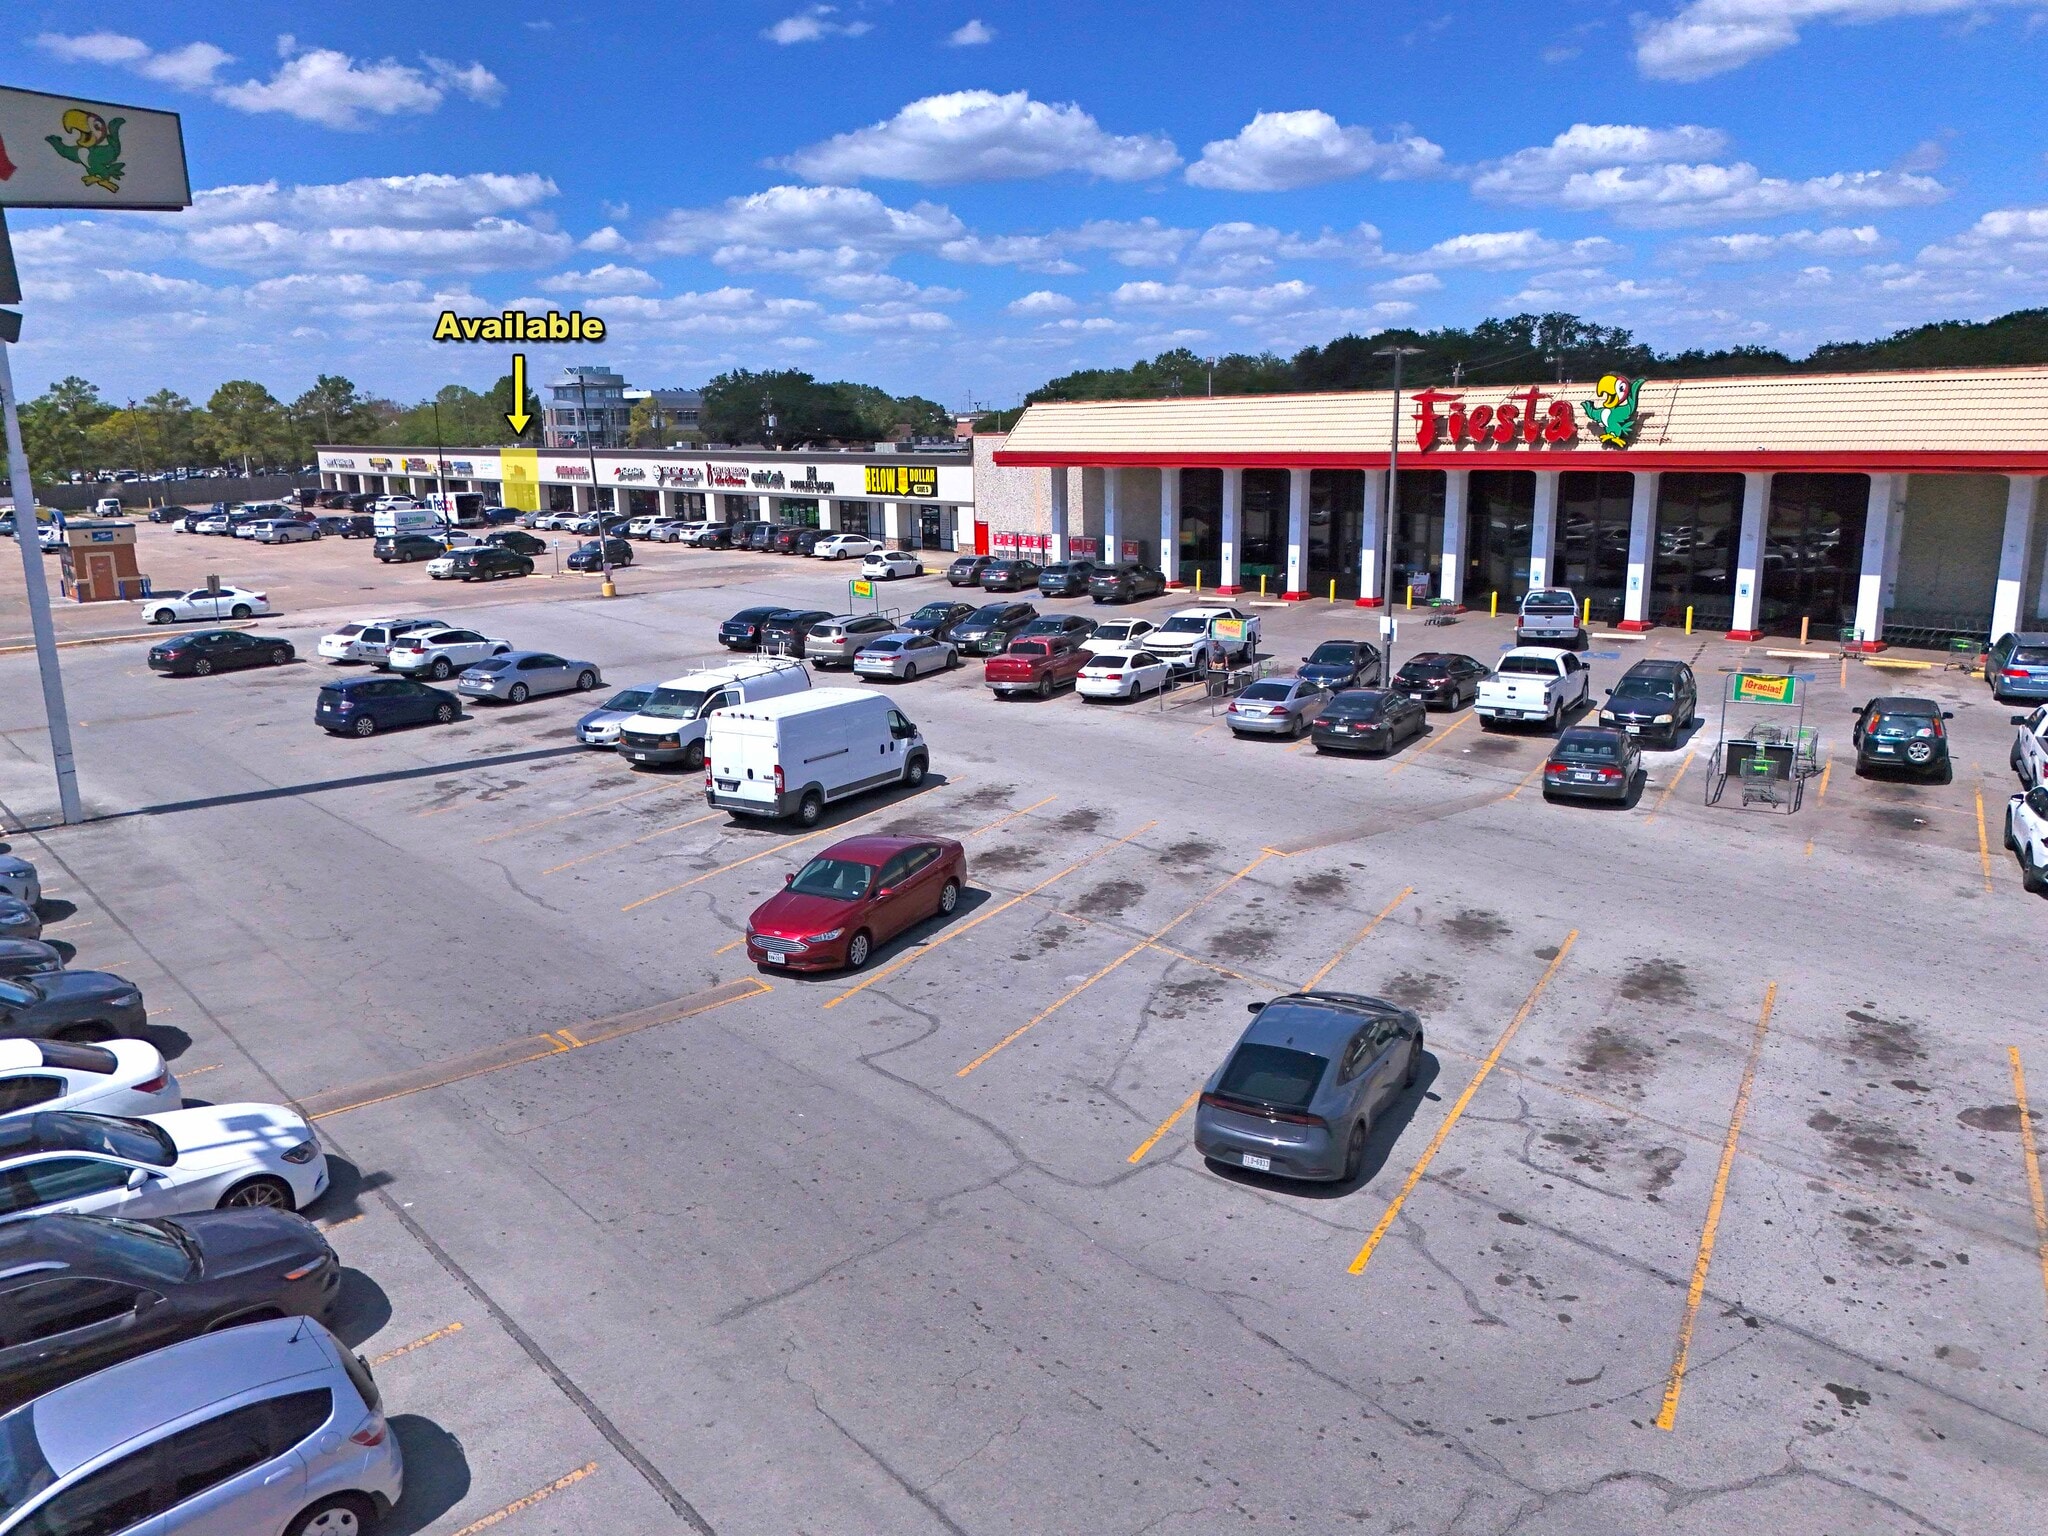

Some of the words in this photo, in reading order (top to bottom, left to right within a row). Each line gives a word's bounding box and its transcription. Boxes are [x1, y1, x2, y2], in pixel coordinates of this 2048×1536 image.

[1411, 386, 1577, 451] Fiesta
[865, 467, 895, 492] BELOW
[909, 468, 935, 482] DOLLAR
[1744, 679, 1783, 694] ¡Gracias!
